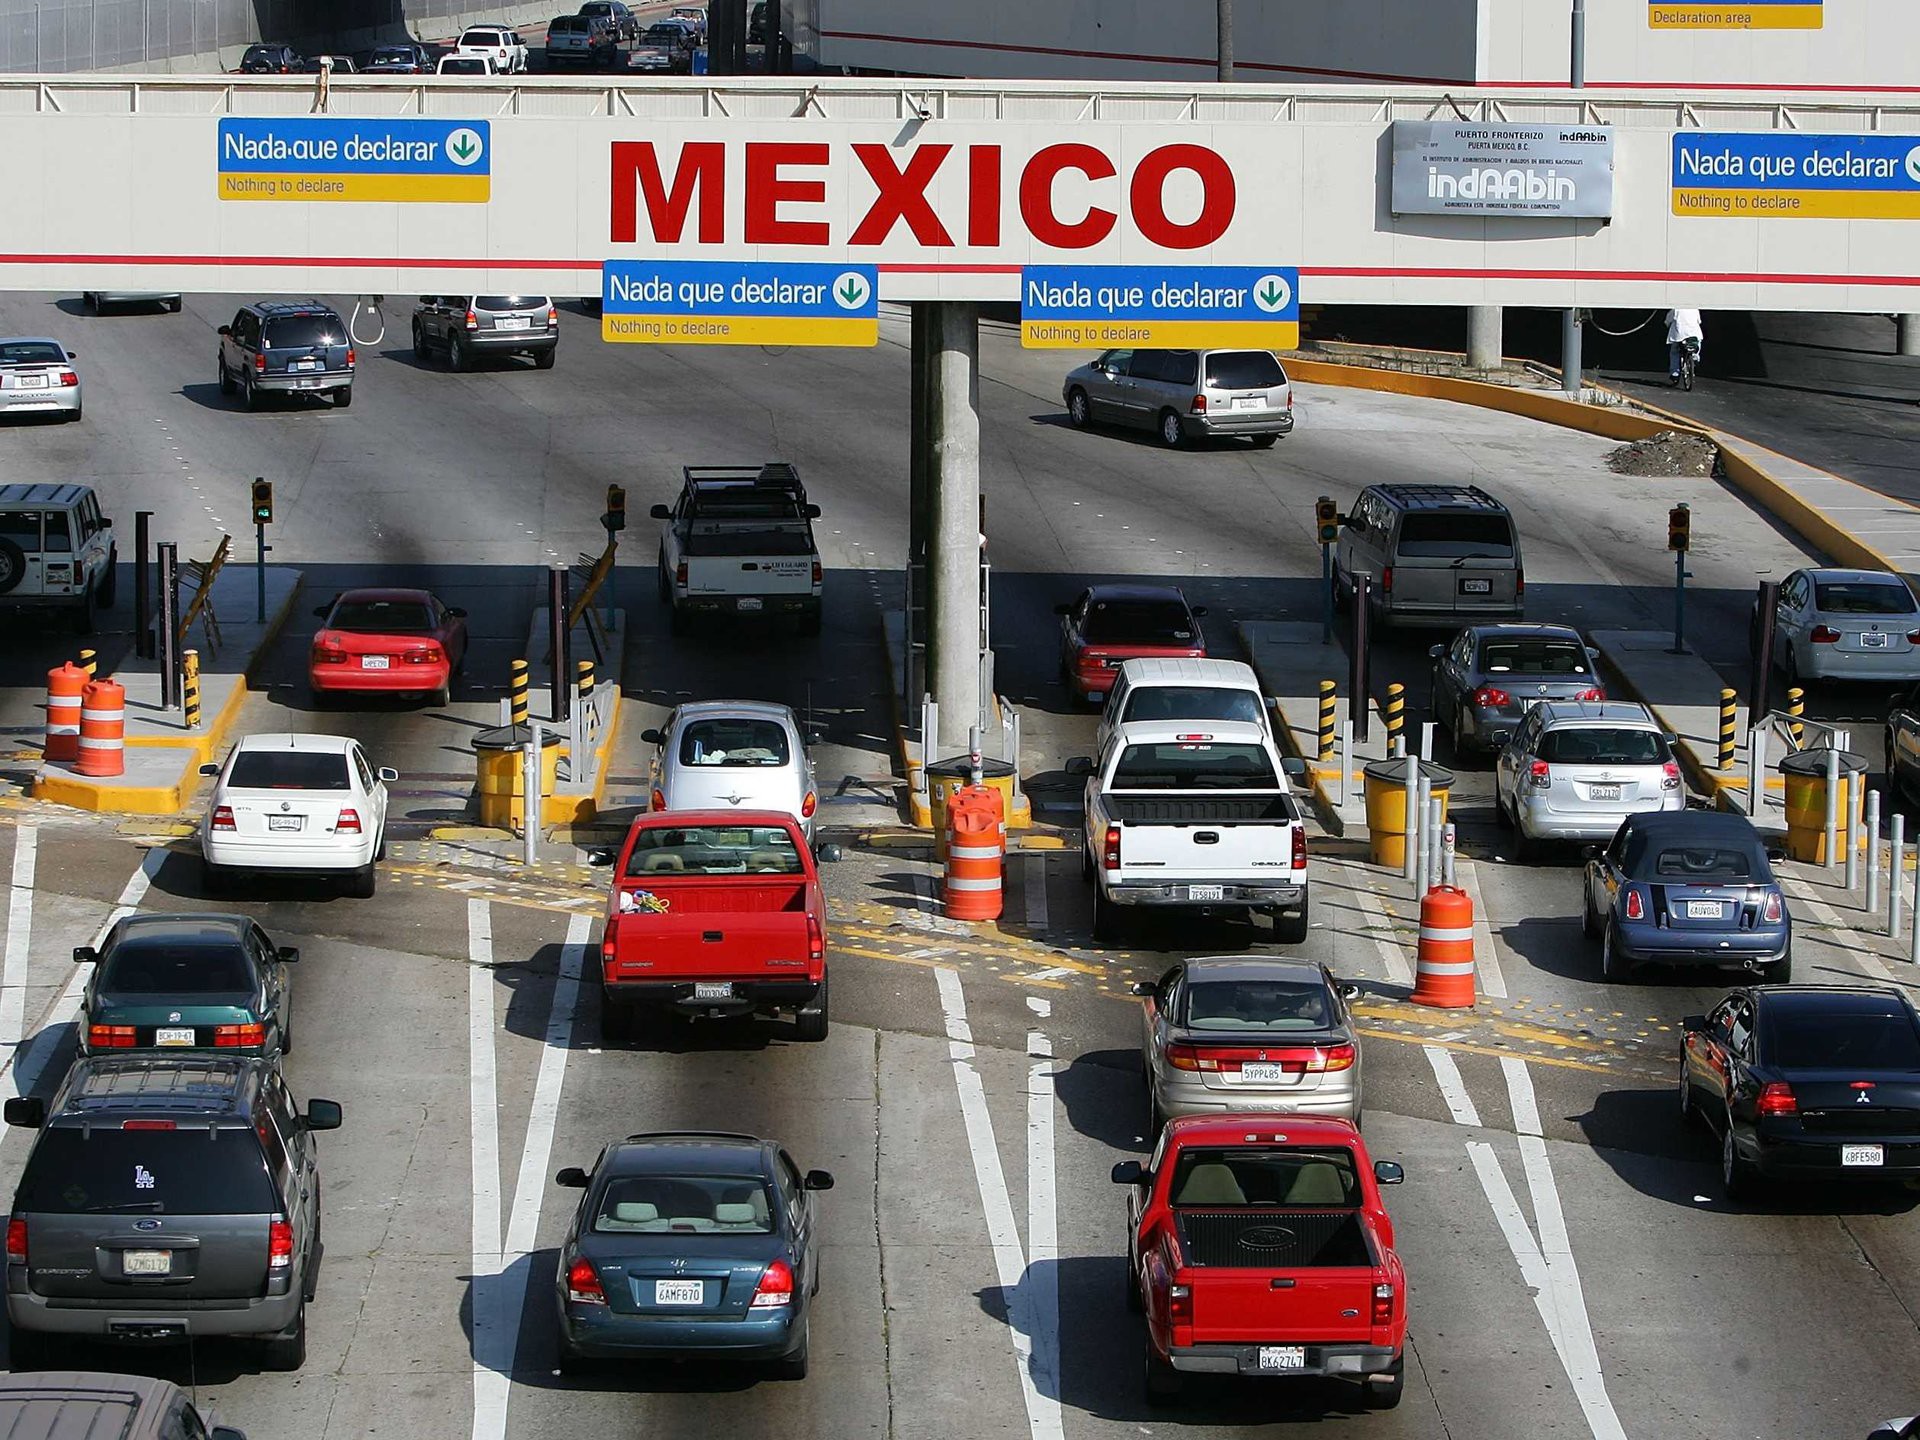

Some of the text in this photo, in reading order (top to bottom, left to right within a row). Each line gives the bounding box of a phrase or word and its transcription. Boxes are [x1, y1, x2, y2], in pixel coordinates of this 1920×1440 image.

[1653, 10, 1751, 24] Declaration area
[1454, 130, 1544, 141] PUERTO FRONTERIZO
[225, 132, 287, 160] Nada
[343, 133, 438, 161] declarar
[1467, 141, 1491, 150] PUERTA
[1679, 147, 1899, 182] Nada que declarar
[226, 178, 344, 195] Nothing to declare
[611, 140, 1236, 250] MEXICO
[1679, 193, 1800, 212] Nothing to declare
[610, 274, 827, 309] Nada que declarar
[1028, 280, 1247, 314] Nada que declarar
[610, 319, 730, 337] Nothing to declare
[1029, 325, 1151, 343] Nothing to declare
[658, 1288, 700, 1301] 6AMF870
[1261, 1355, 1303, 1368] 8K62747
